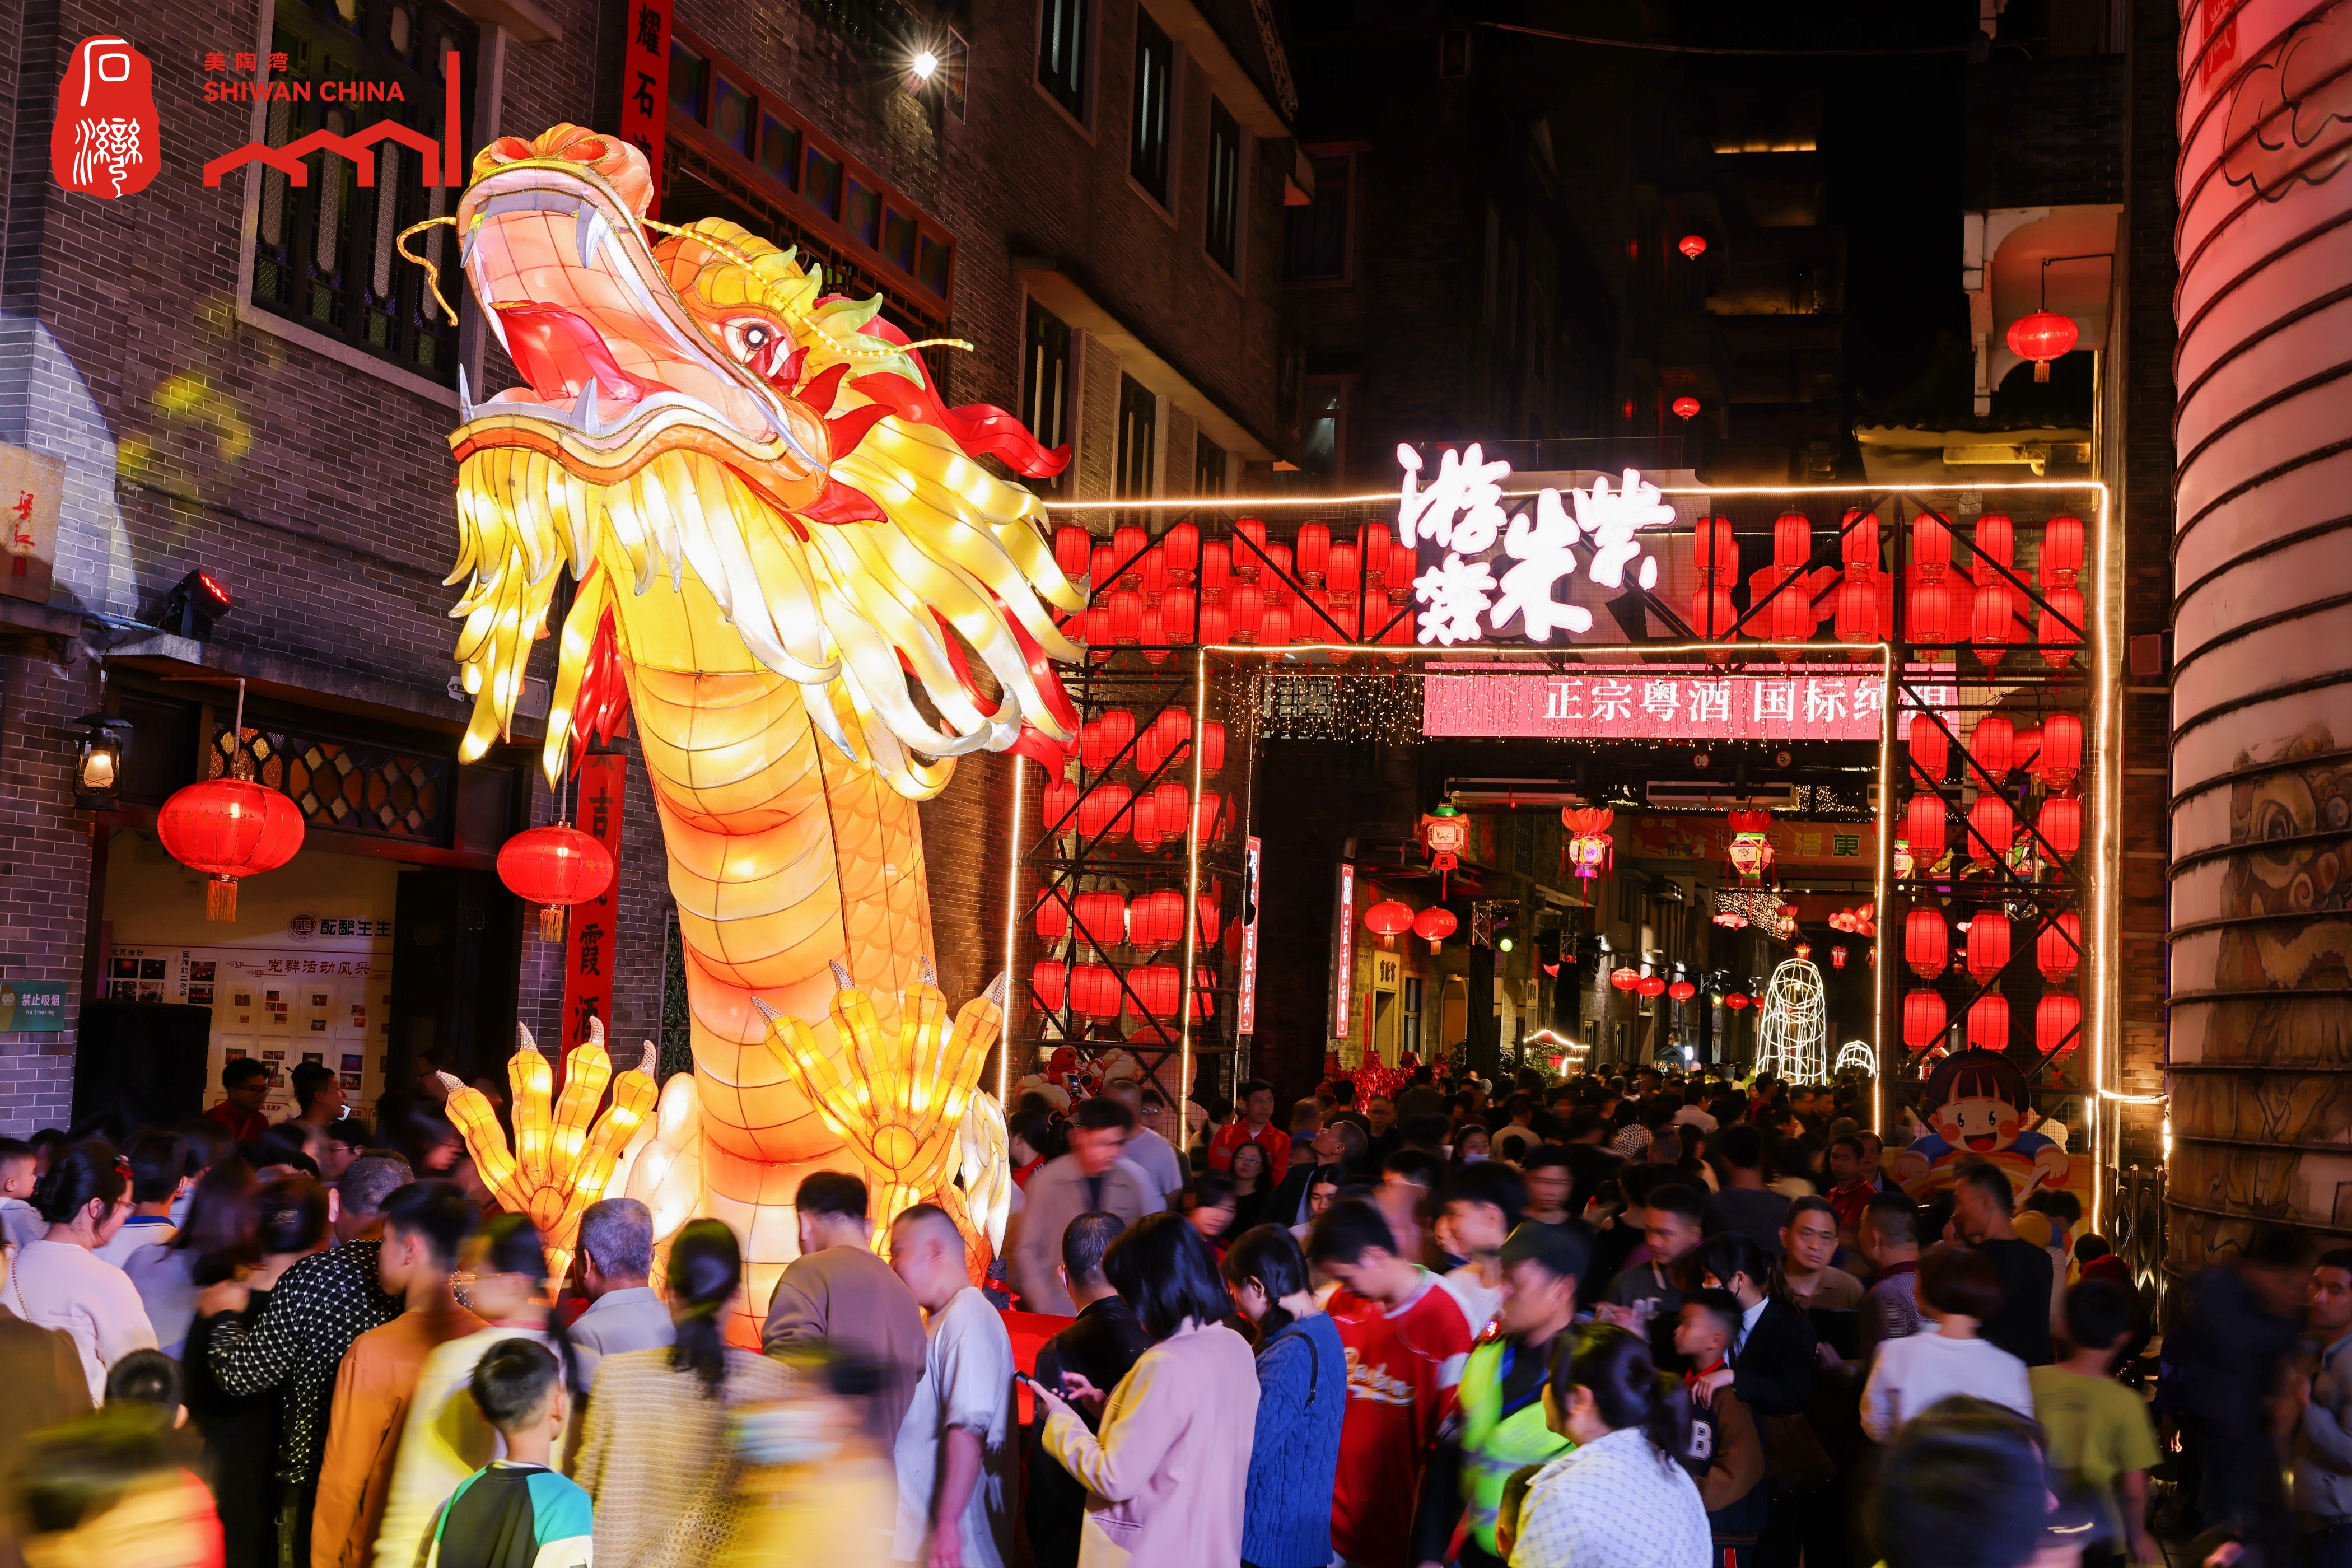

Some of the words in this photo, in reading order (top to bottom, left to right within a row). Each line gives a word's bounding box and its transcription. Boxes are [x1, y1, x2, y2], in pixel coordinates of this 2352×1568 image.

[1542, 679, 1730, 722] 正宗粤酒
[179, 951, 190, 998] 困难职工慰问
[268, 958, 371, 976] 党群活动风采
[21, 993, 60, 1006] 禁止吸烟
